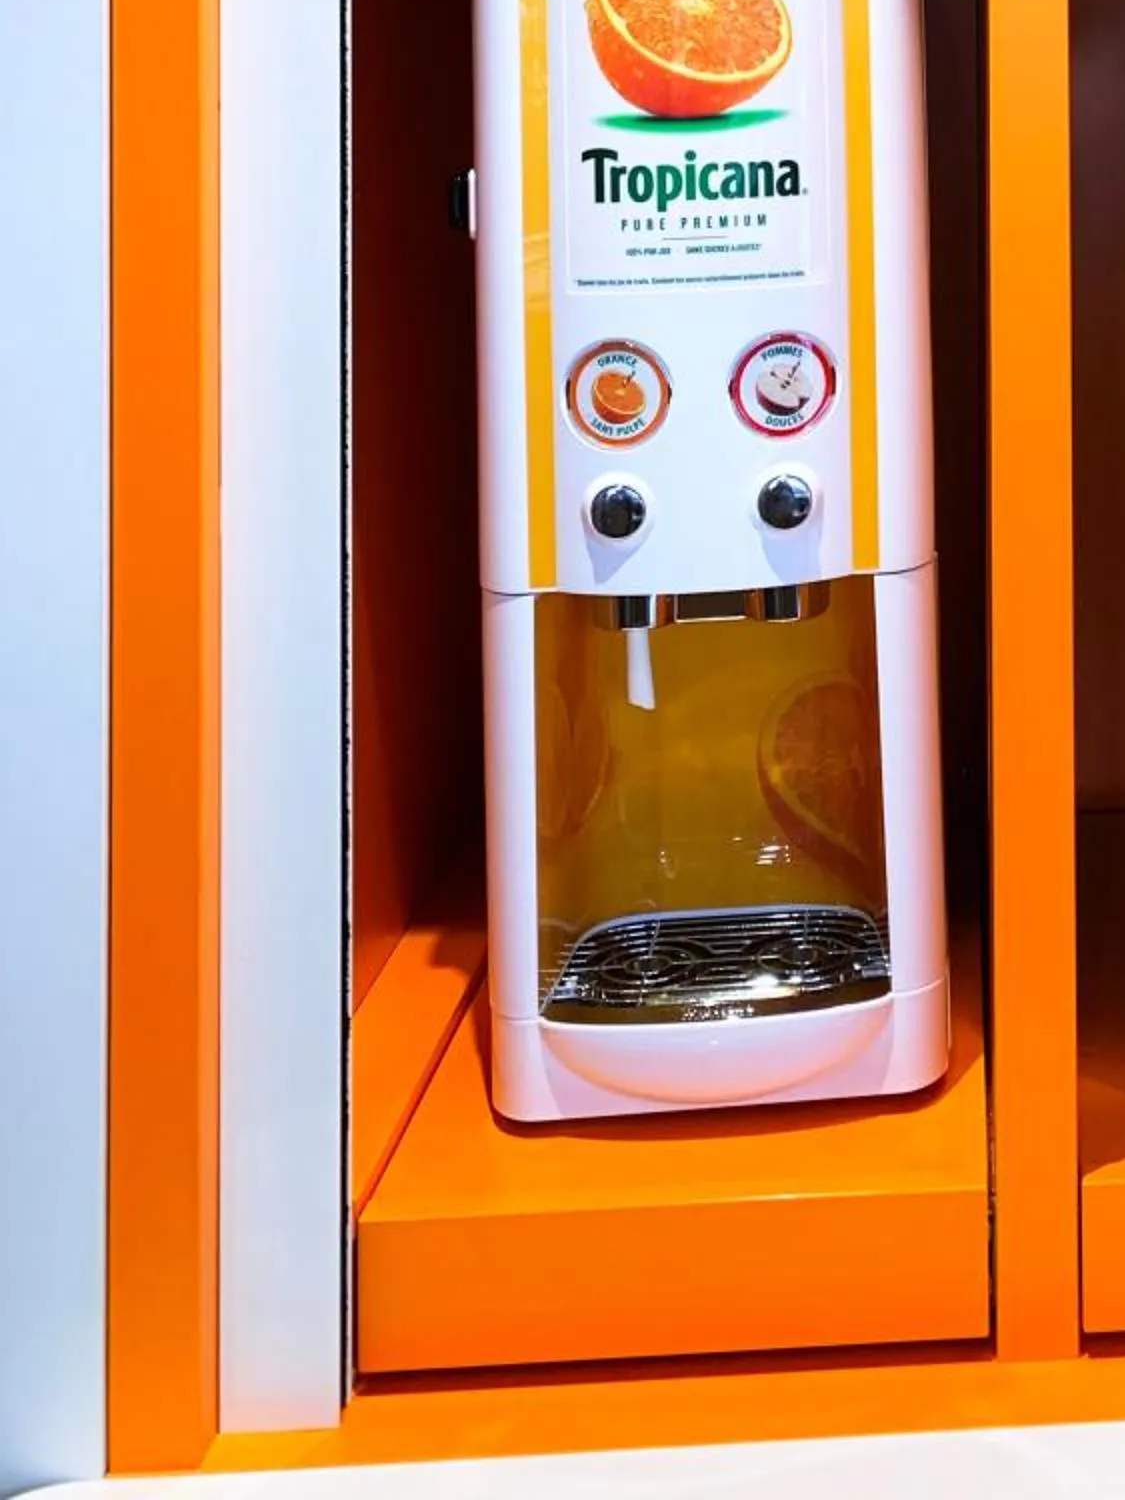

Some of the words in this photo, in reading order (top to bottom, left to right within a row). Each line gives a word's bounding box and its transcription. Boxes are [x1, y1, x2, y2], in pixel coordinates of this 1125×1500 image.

[582, 145, 802, 213] Tropicana
[621, 217, 666, 232] PURE
[681, 213, 768, 230] PREMIUM
[597, 354, 638, 367] ORANGE
[761, 345, 804, 361] POMMES
